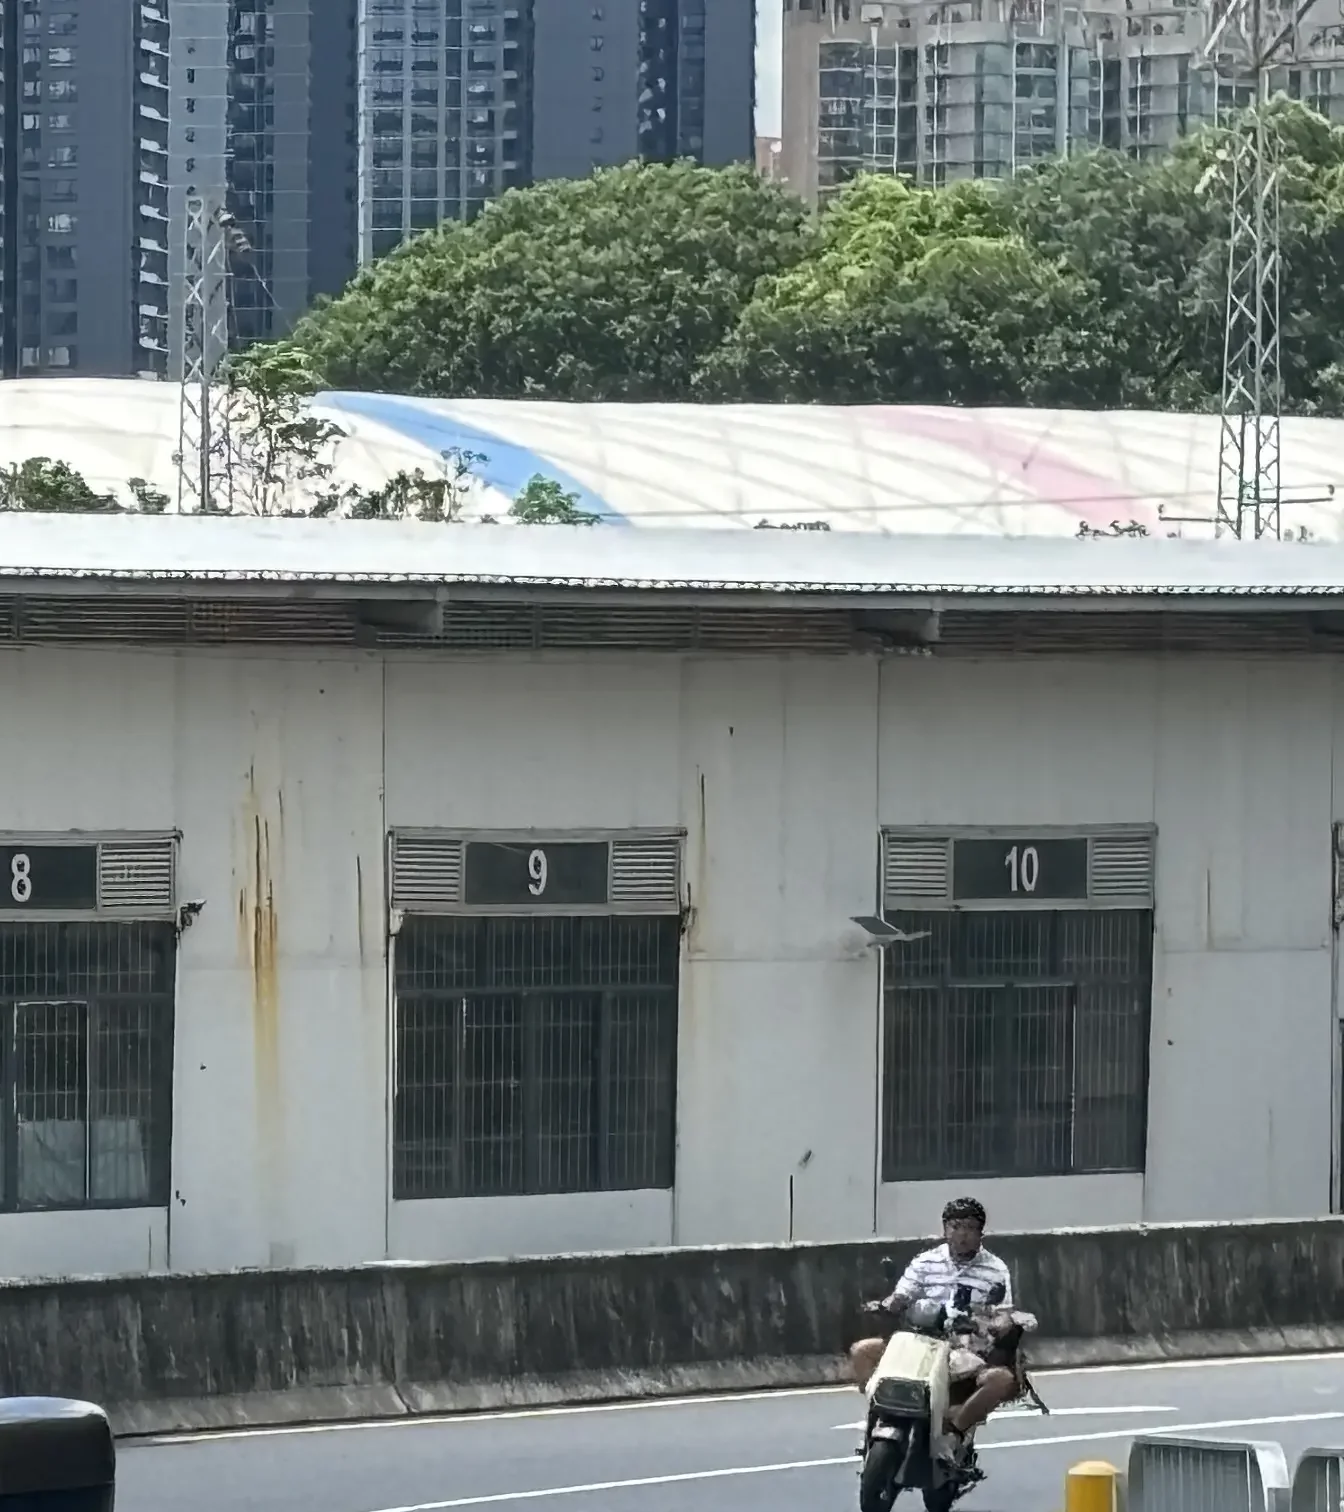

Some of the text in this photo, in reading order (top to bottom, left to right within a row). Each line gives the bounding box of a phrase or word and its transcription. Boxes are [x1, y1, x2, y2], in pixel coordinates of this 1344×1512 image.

[11, 852, 32, 902] 8
[528, 848, 548, 896] 9
[1004, 845, 1039, 892] 10
